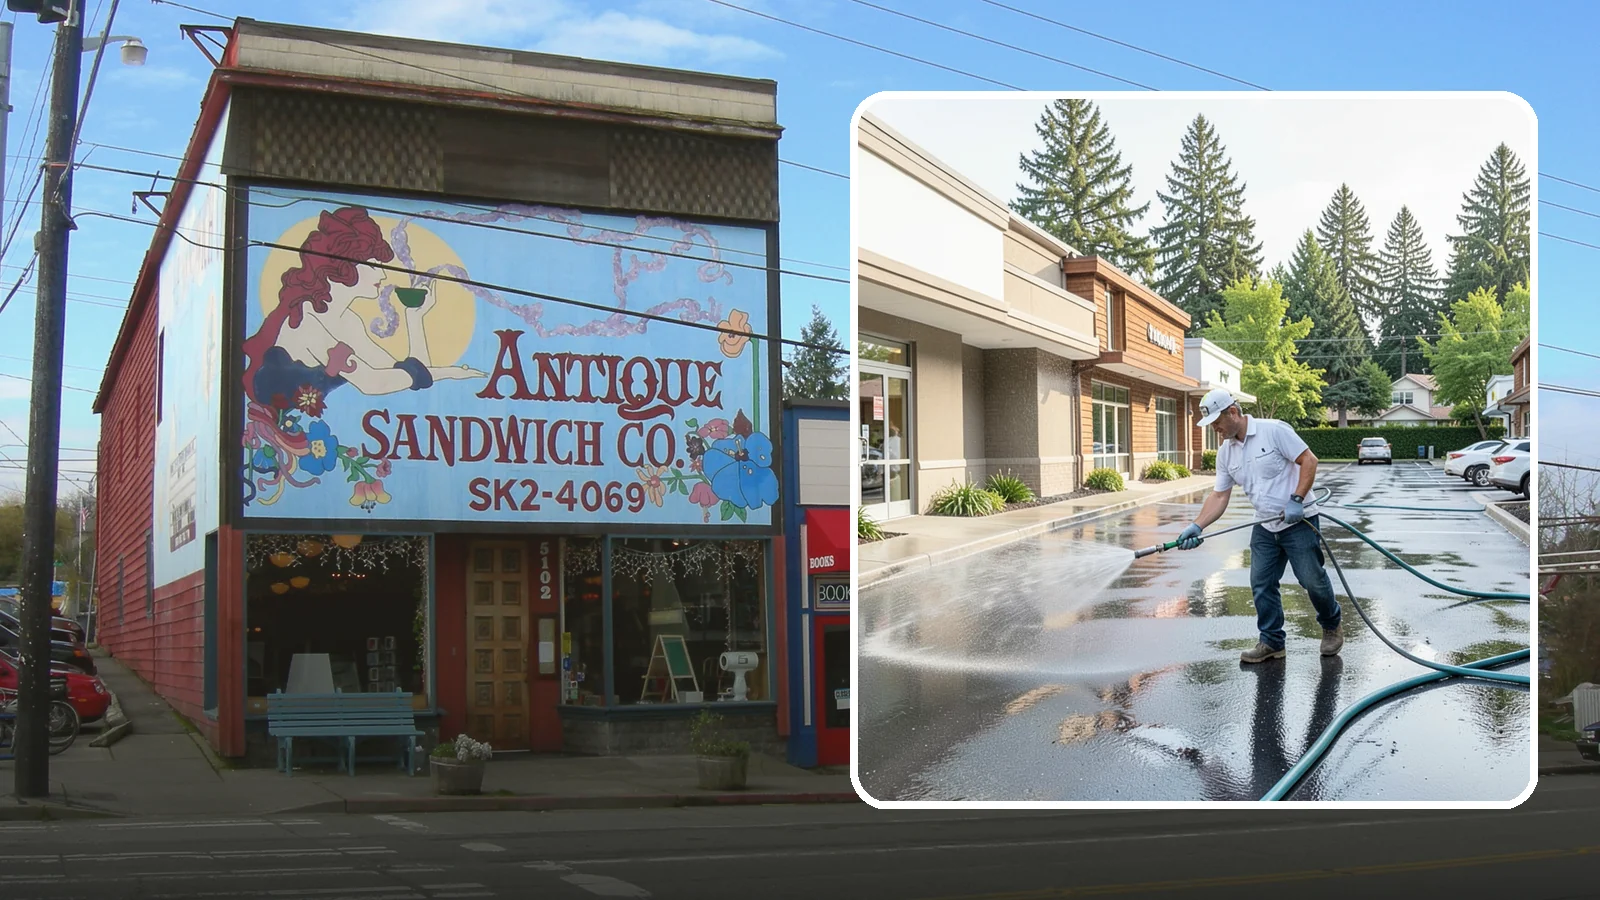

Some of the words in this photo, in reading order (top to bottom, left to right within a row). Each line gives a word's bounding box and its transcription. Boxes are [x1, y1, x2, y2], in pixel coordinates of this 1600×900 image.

[475, 329, 724, 421] ANTIQUE
[361, 408, 604, 467] SANDWICH
[617, 421, 685, 469] CO.
[468, 476, 646, 513] SK2-4069
[539, 542, 552, 599] 5102
[809, 555, 835, 568] BOOKS
